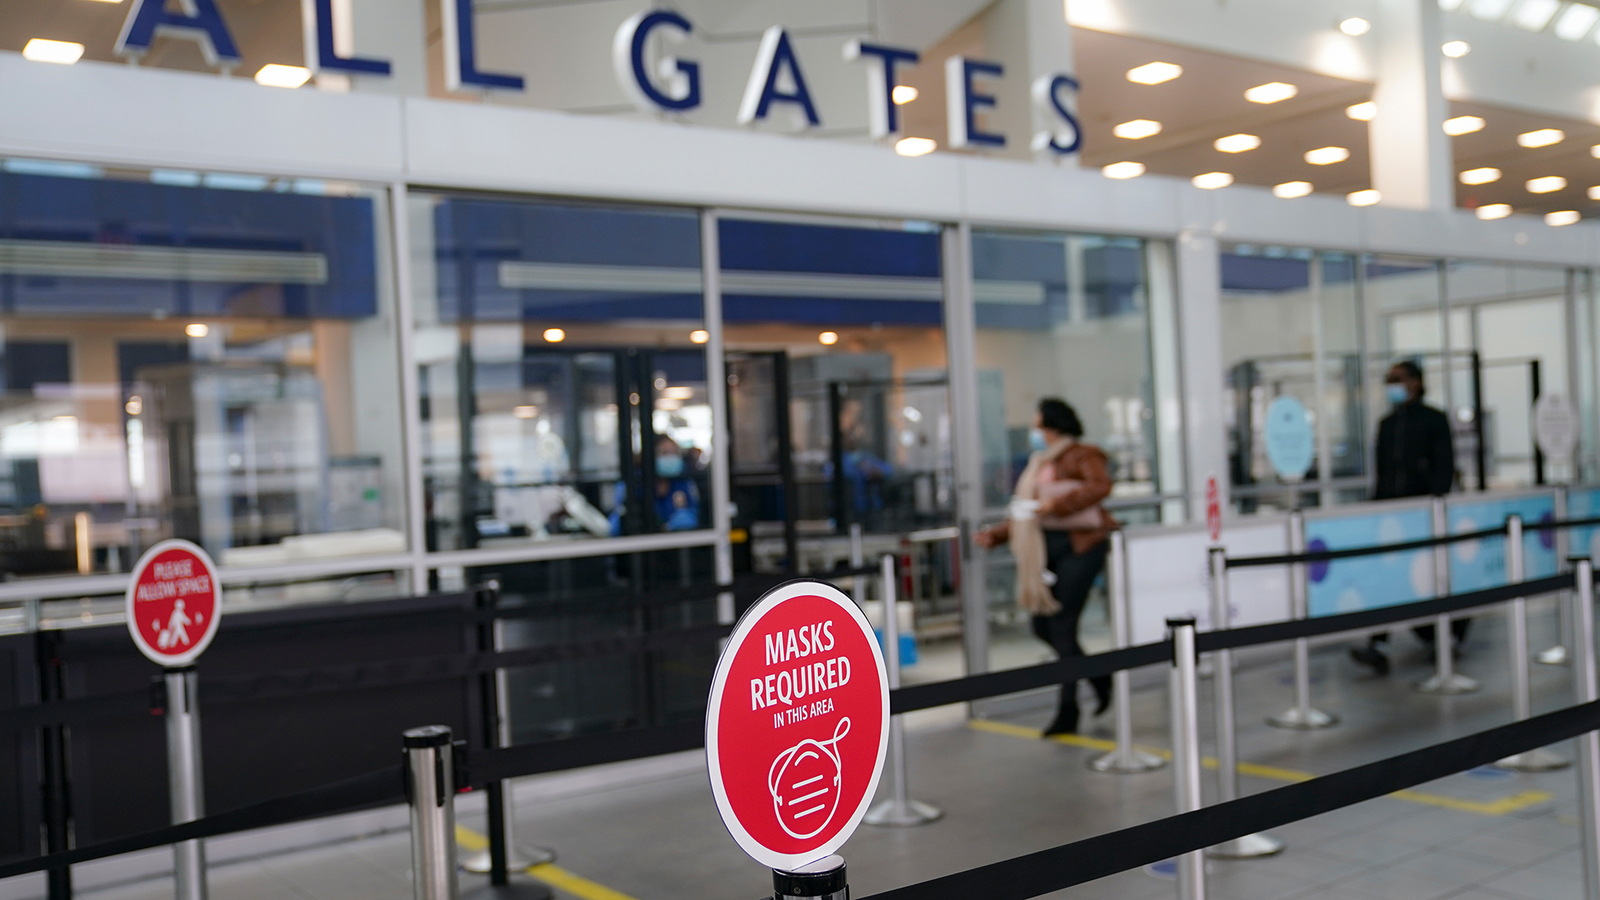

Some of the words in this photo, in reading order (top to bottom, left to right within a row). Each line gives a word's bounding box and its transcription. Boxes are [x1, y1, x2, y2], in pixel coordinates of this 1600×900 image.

[115, 0, 525, 91] ALL
[614, 9, 1084, 154] GATES
[137, 580, 176, 602] ALLOW
[177, 574, 210, 597] SPACE
[153, 559, 193, 580] PLEASE
[765, 620, 835, 666] MASKS
[750, 656, 851, 711] REQUIRED
[773, 711, 785, 729] IN
[786, 705, 808, 724] THIS
[810, 697, 834, 718] AREA
